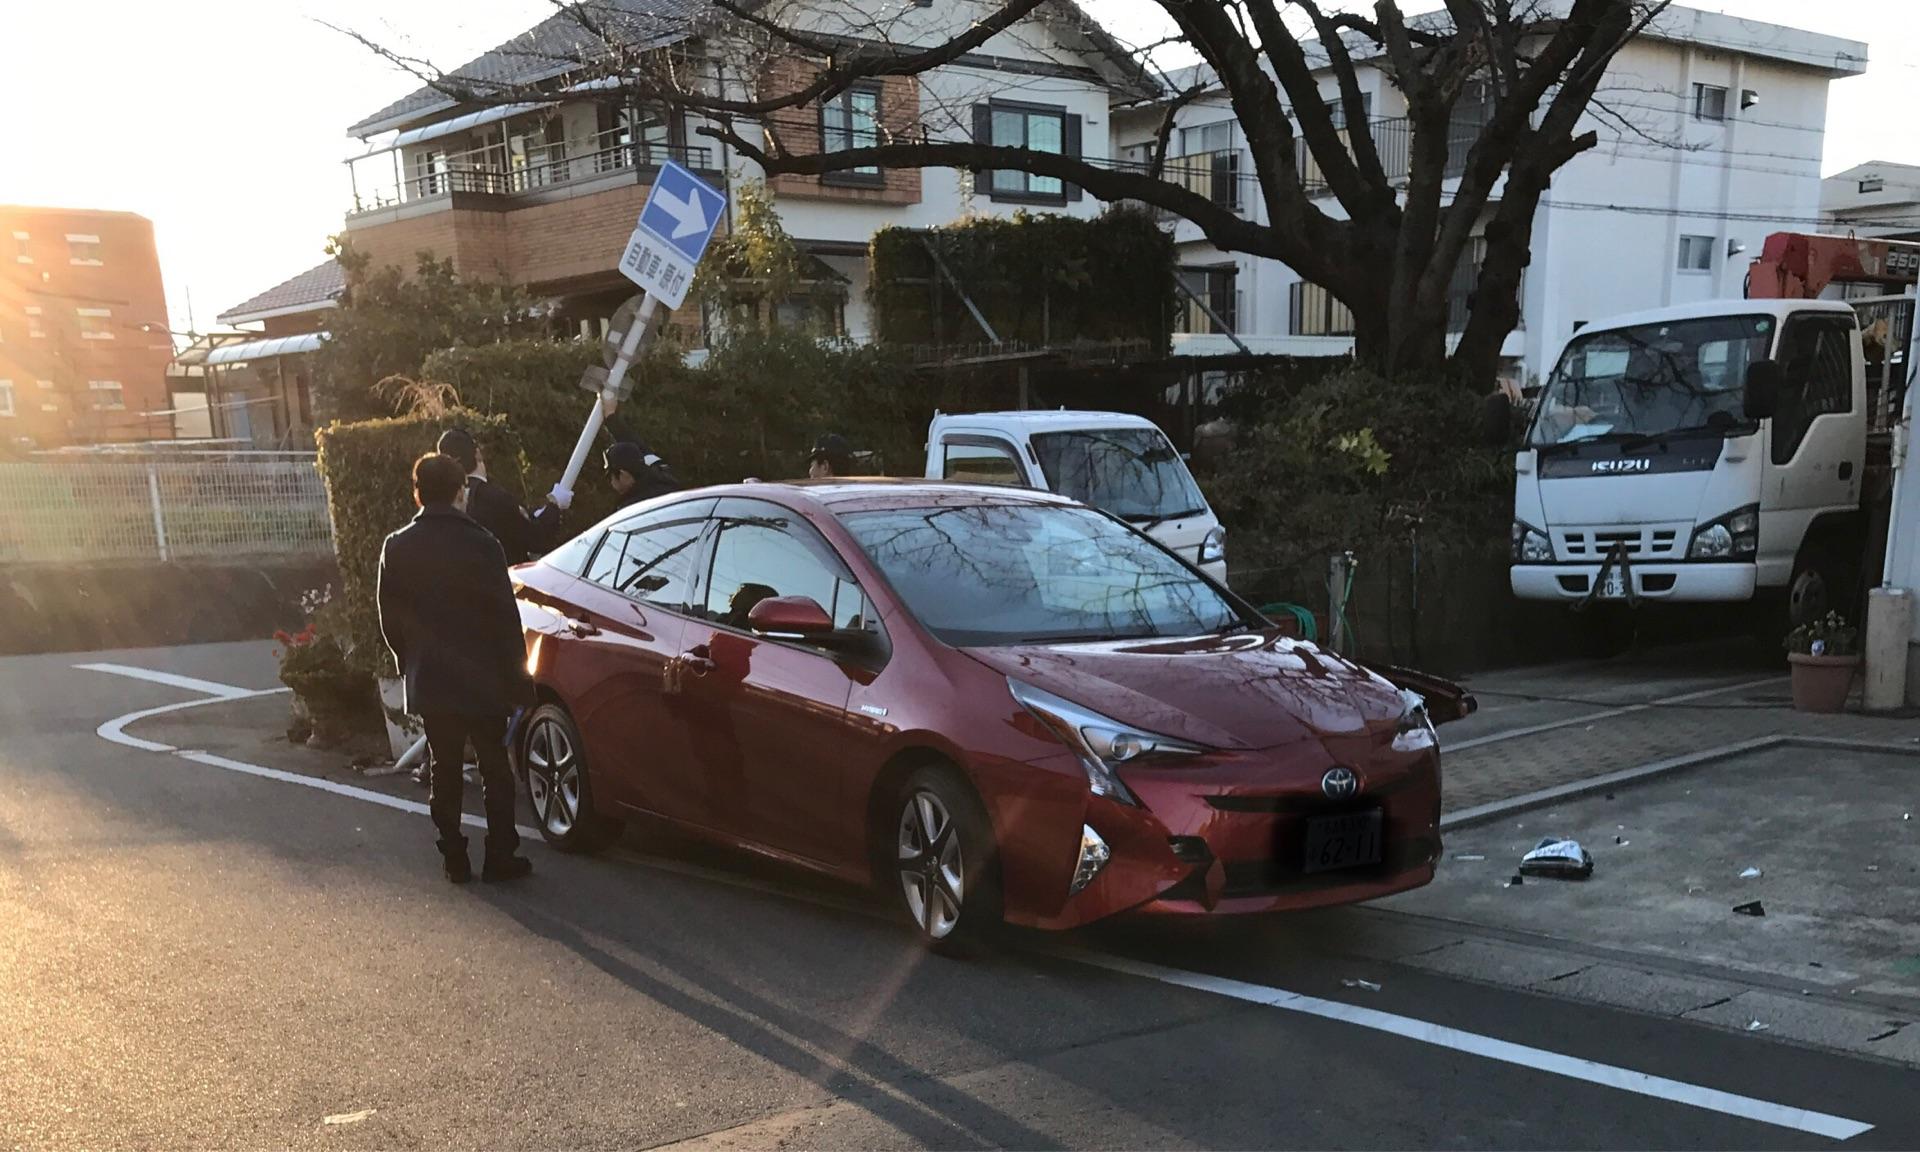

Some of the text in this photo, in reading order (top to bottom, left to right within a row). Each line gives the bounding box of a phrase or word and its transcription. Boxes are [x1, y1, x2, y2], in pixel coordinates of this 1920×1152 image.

[627, 242, 686, 297] 自動車・原付
[1592, 458, 1650, 471] ISUZU
[1320, 832, 1374, 865] 62-11
